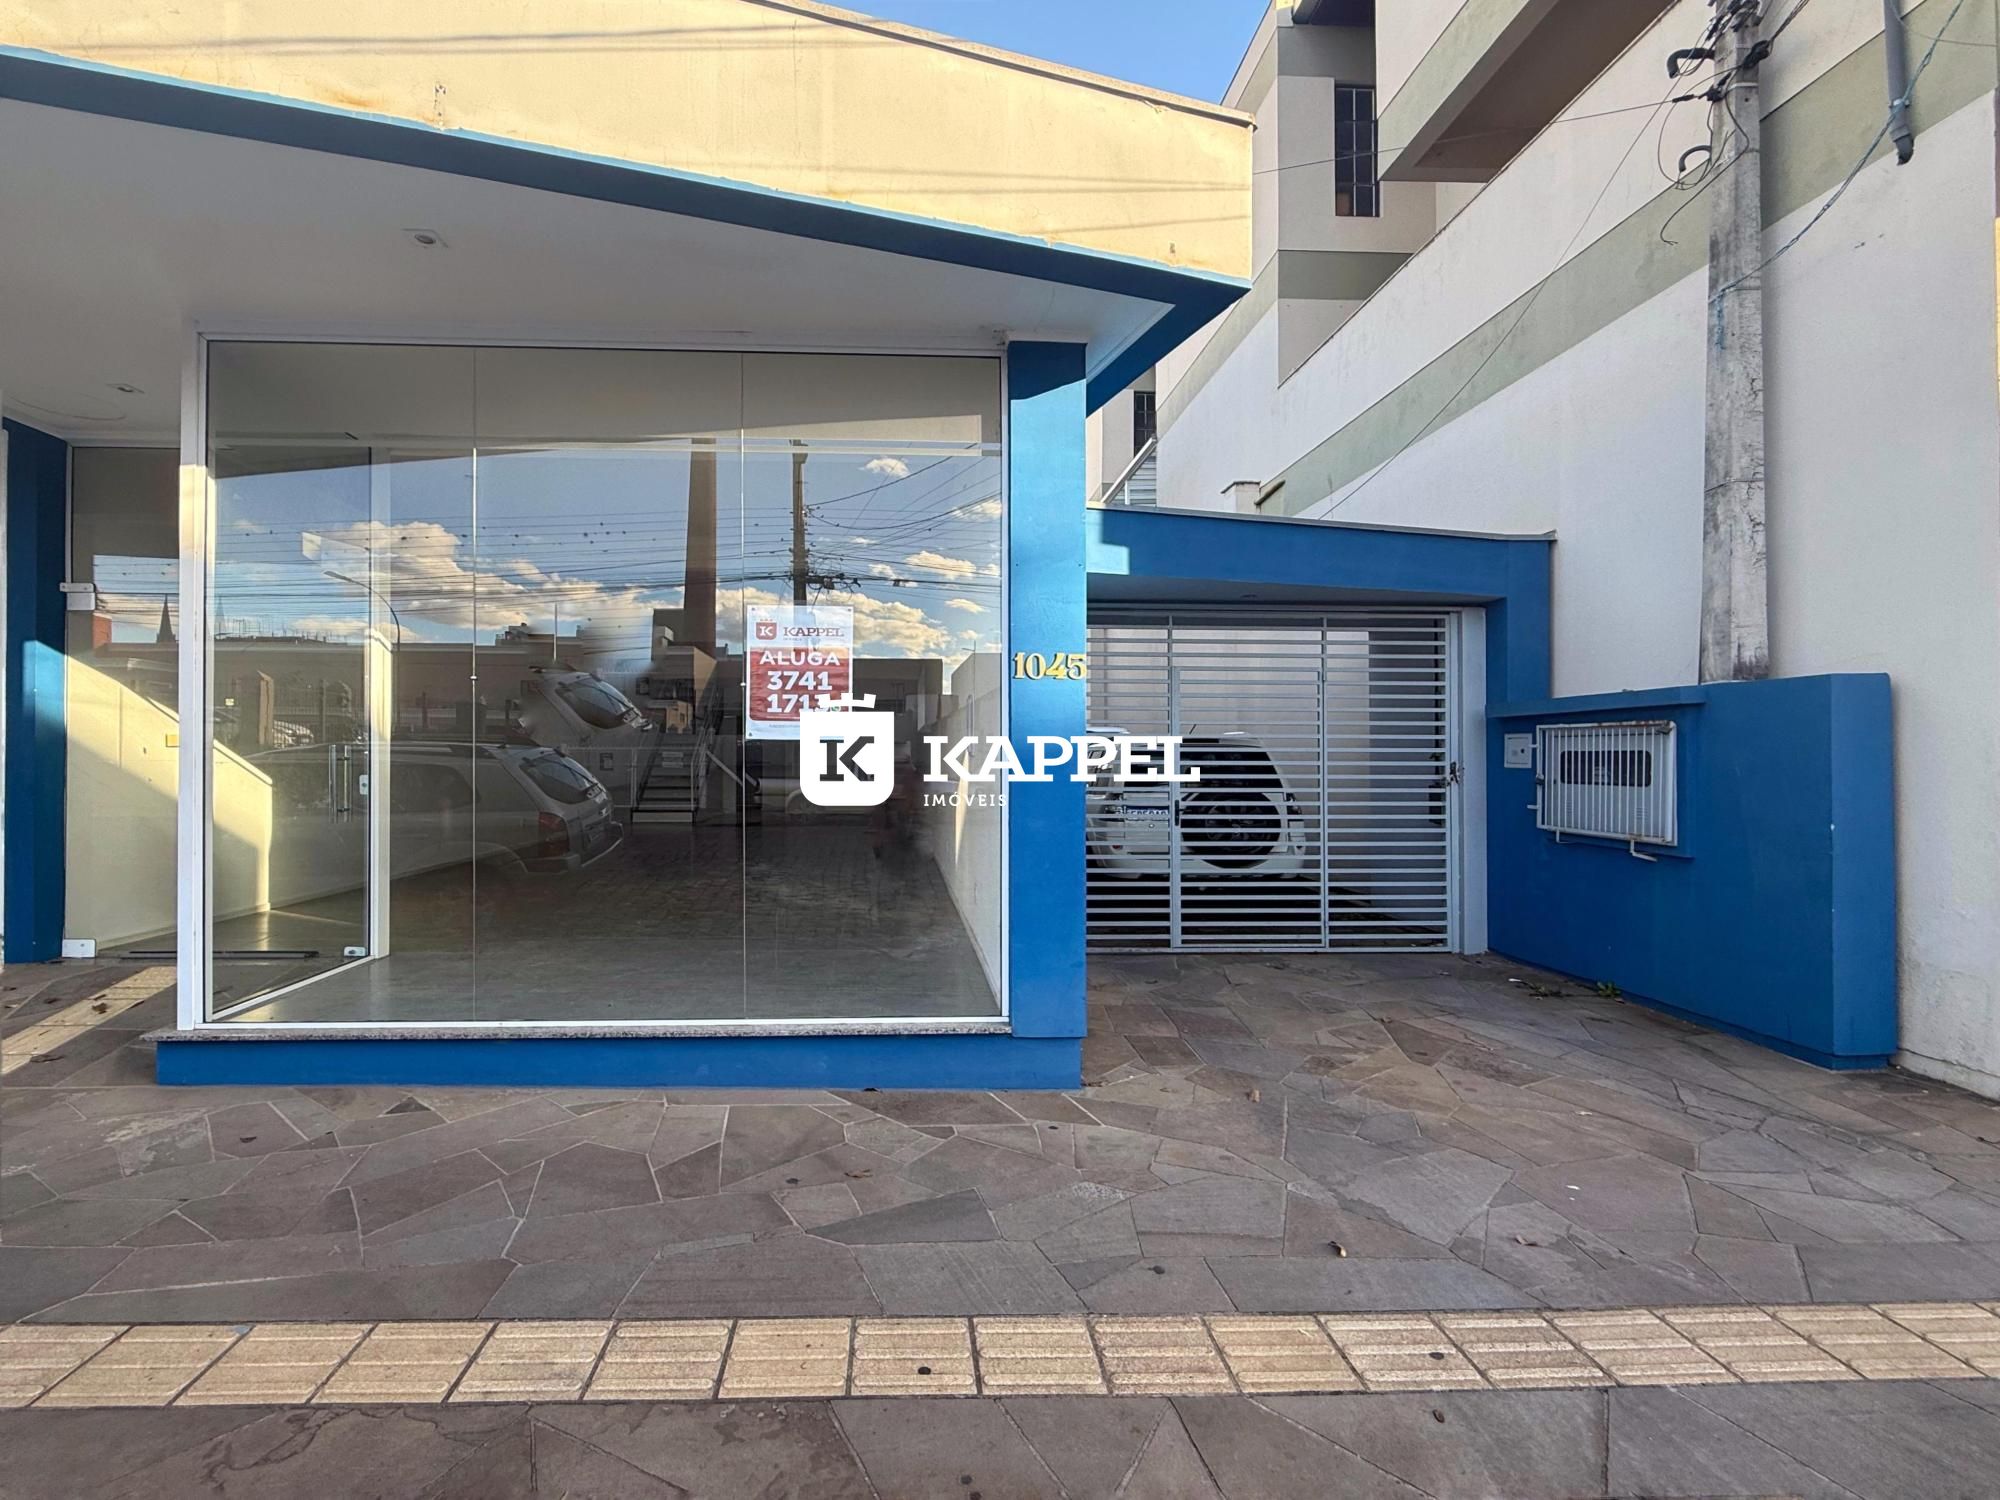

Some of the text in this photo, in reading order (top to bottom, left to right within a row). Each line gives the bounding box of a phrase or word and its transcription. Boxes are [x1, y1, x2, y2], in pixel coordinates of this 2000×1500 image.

[783, 627, 845, 637] KAPPEL
[759, 650, 841, 666] ALUGA
[1012, 651, 1088, 680] 1045
[767, 670, 833, 691] 3741
